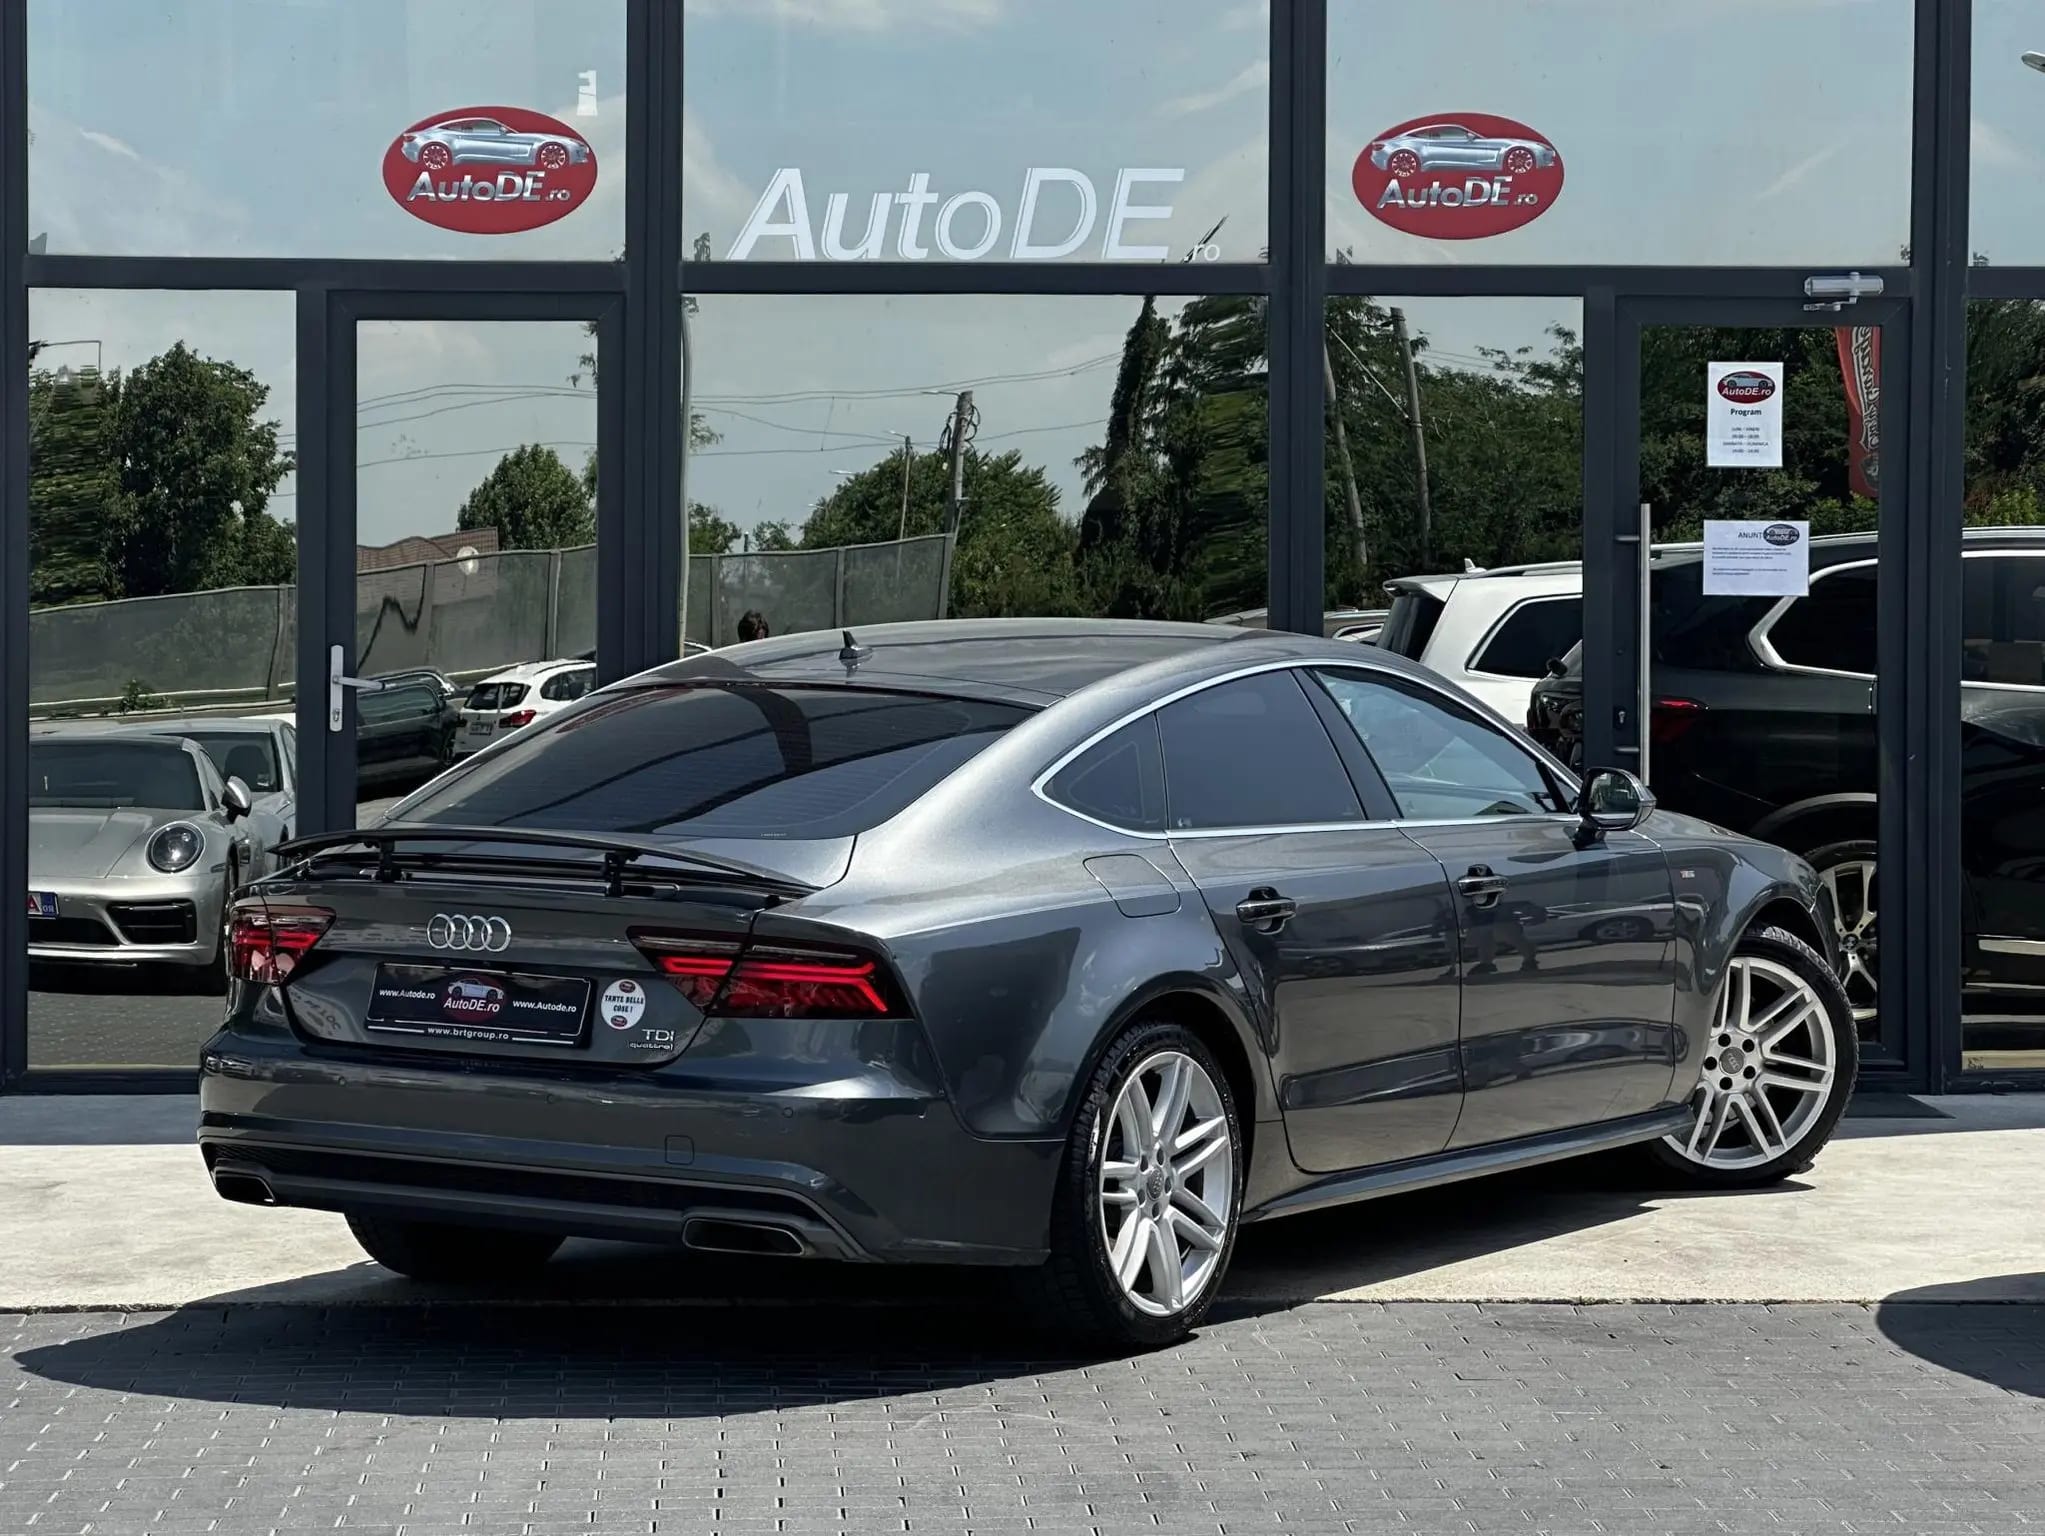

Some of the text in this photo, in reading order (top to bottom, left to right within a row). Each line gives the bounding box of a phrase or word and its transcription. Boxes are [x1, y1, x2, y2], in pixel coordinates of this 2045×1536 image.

[406, 170, 571, 202] AutoDE.ro
[1376, 175, 1539, 209] AutoDE.ro
[1730, 408, 1762, 416] Program
[378, 988, 437, 1000] www.Autode.ro
[442, 997, 501, 1013] AutoDE.ro
[511, 999, 578, 1013] www.Autode.ro
[642, 1029, 675, 1041] TDI
